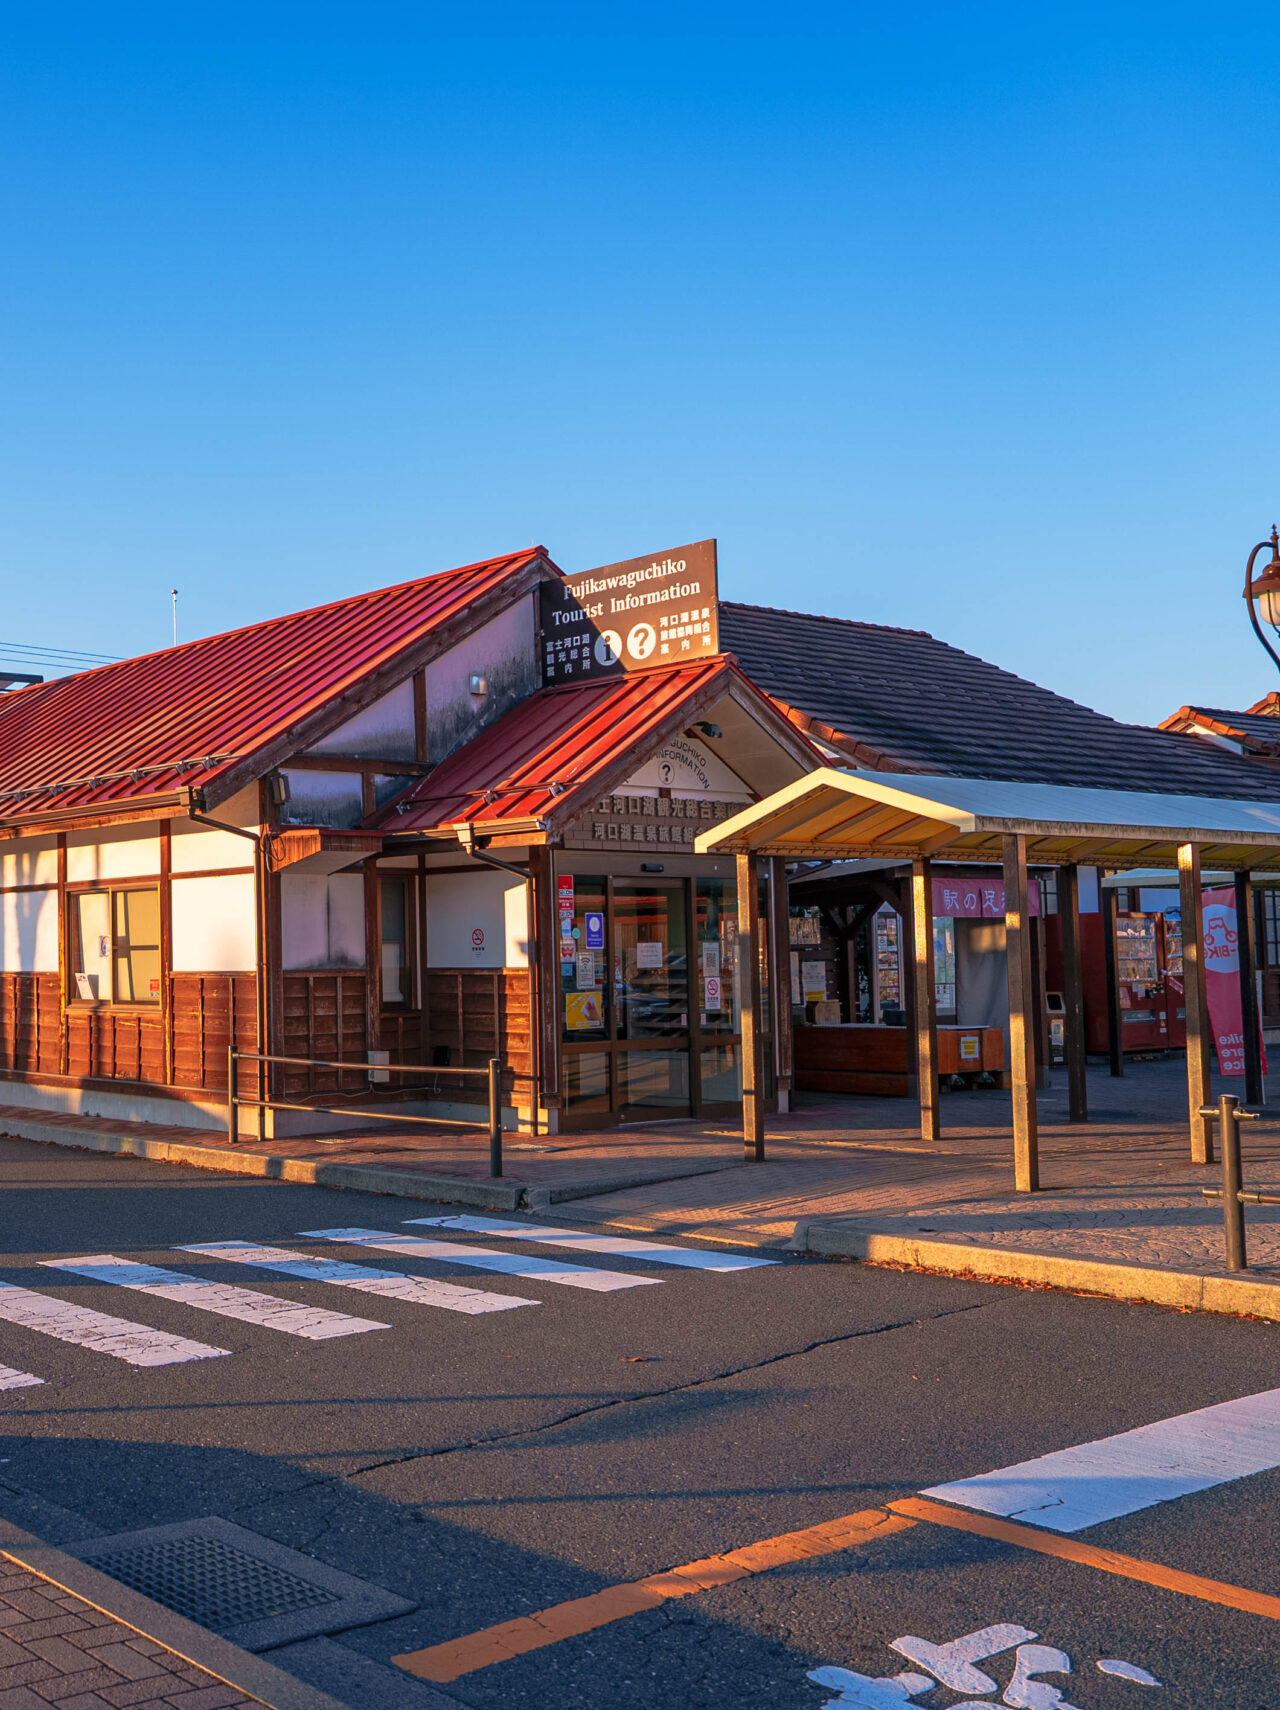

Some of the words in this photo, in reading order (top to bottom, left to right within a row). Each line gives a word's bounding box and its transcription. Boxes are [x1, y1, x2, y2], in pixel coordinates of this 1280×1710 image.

[563, 558, 687, 600] Fujikawaguchiko
[552, 602, 604, 626] Tourist
[610, 581, 701, 613] Information
[546, 633, 590, 652] 富士河口湖
